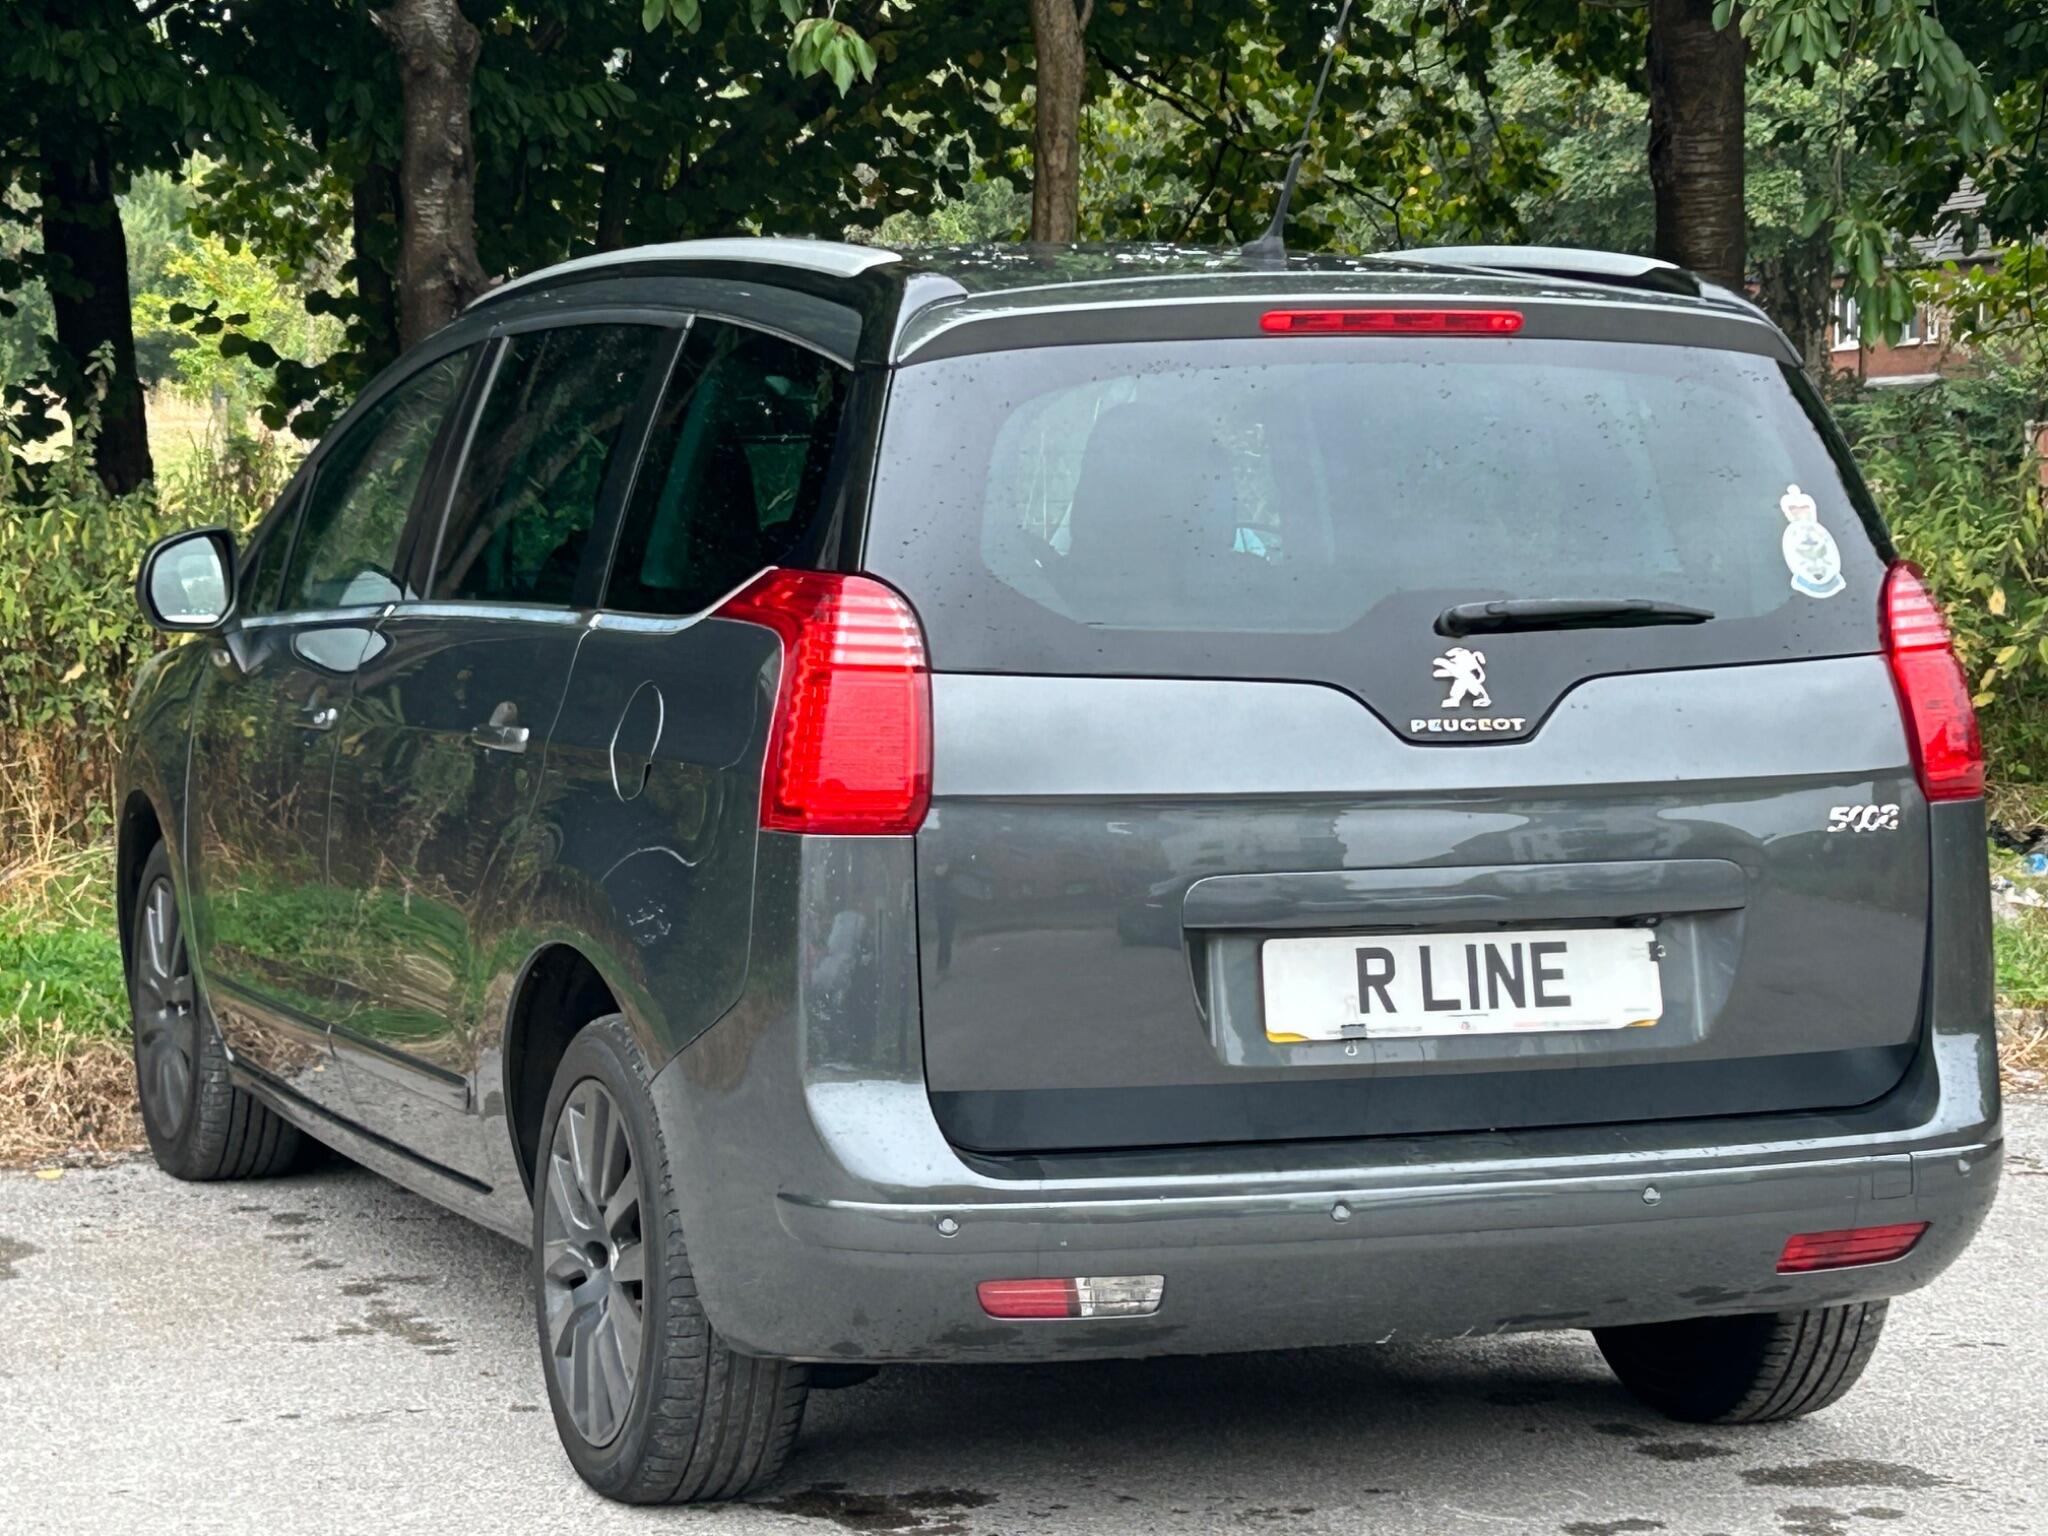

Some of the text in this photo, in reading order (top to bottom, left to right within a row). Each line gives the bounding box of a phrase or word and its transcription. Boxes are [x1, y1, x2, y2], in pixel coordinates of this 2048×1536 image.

[1410, 717, 1526, 733] PEUGEOT
[1355, 941, 1572, 1014] R LINE
